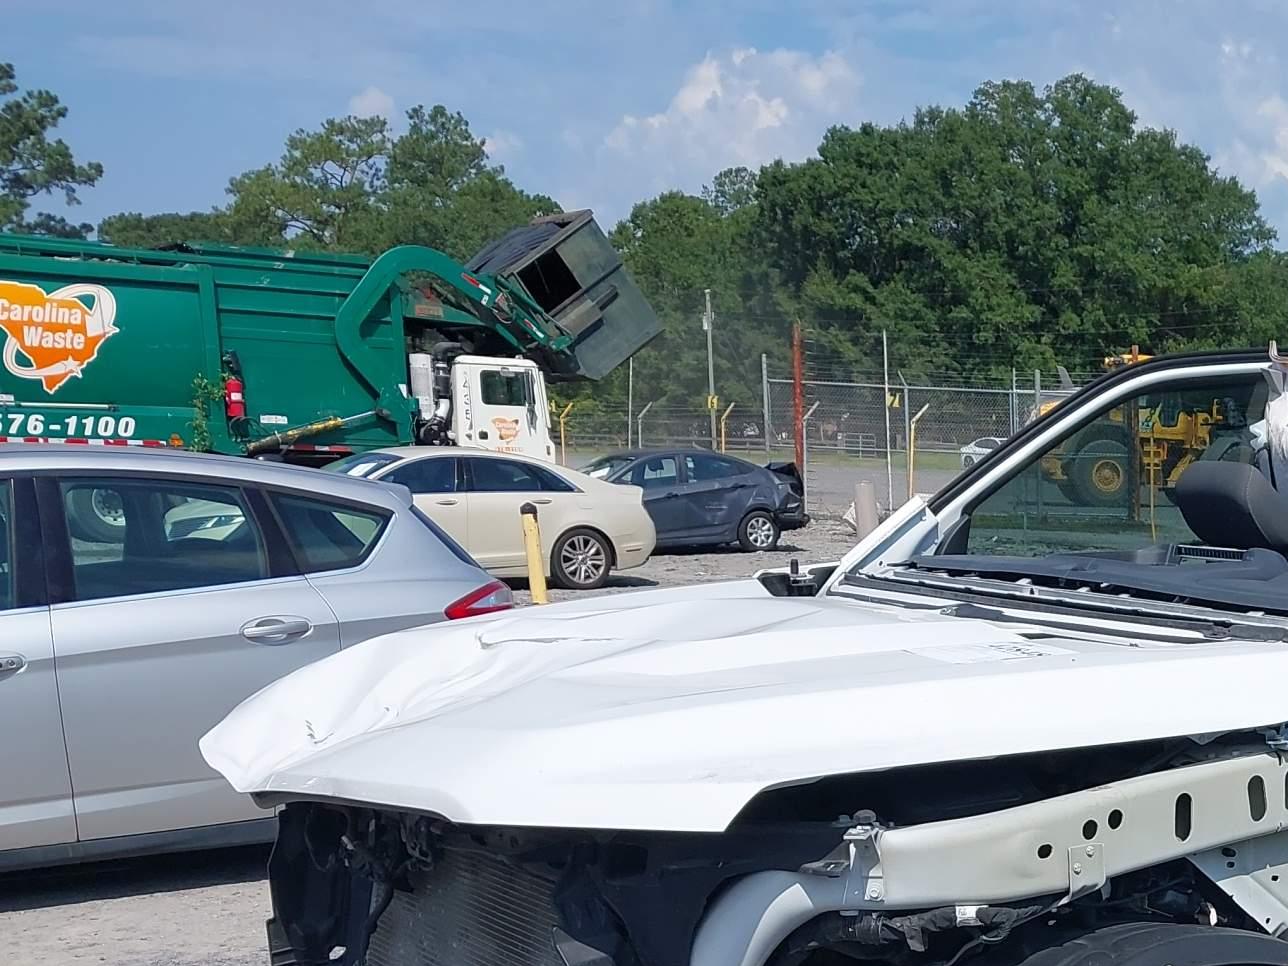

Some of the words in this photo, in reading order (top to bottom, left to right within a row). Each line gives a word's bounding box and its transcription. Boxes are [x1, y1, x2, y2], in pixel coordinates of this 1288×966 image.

[0, 298, 81, 325] Carolina
[23, 325, 85, 350] Waste
[0, 412, 136, 437] 76-1100
